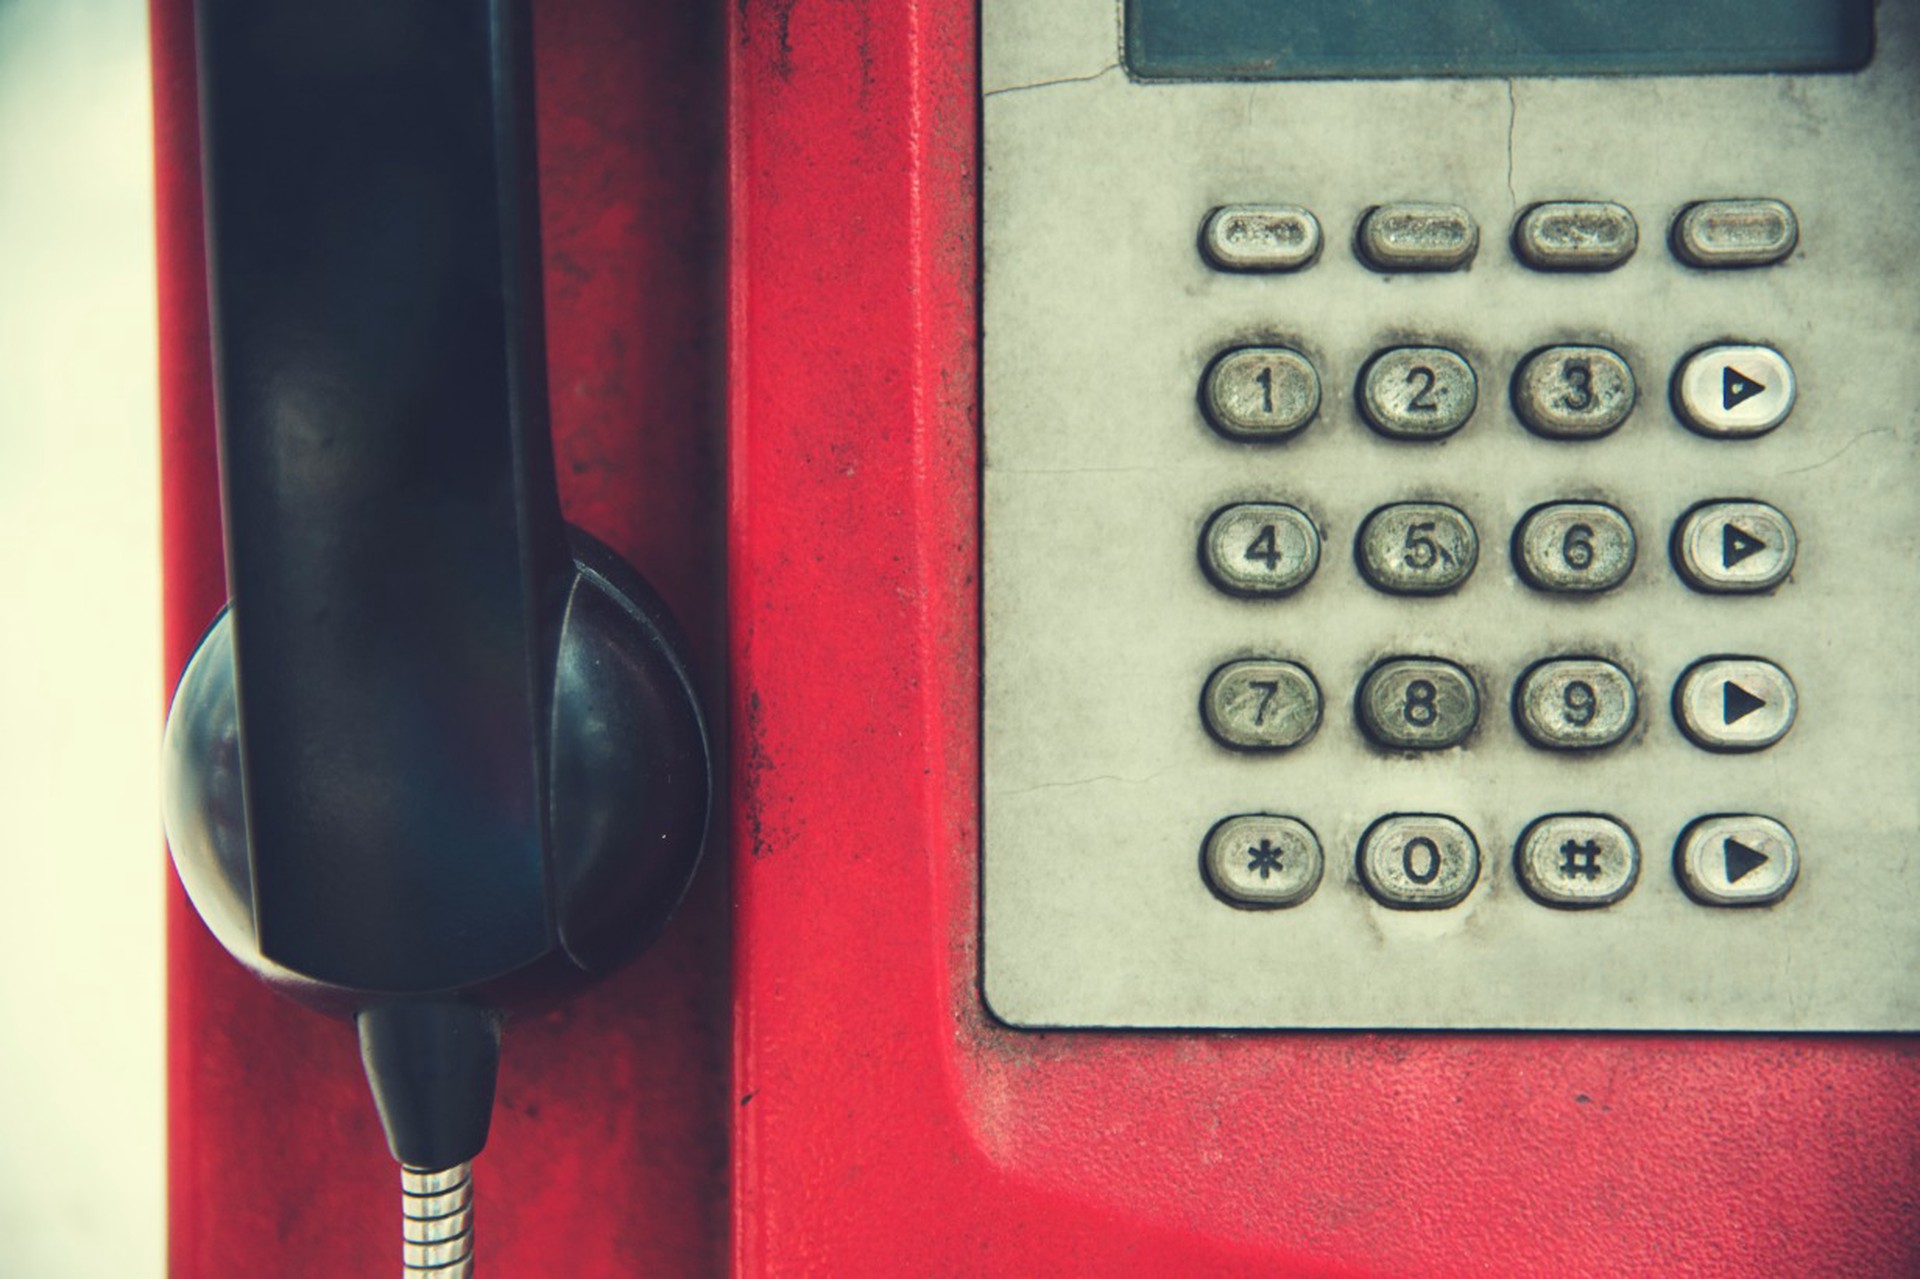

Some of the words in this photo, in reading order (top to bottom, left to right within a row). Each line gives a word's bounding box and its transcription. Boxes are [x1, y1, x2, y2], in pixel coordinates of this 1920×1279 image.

[1254, 367, 1274, 414] 1
[1405, 366, 1439, 412] 2
[1562, 361, 1592, 410] 3
[1244, 525, 1281, 570] 4
[1403, 523, 1437, 570] 5
[1562, 524, 1595, 570] 6
[1248, 681, 1279, 725] 7
[1403, 680, 1438, 727] 8
[1562, 681, 1596, 726] 9
[1403, 837, 1441, 884] 0
[1560, 839, 1601, 880] #
